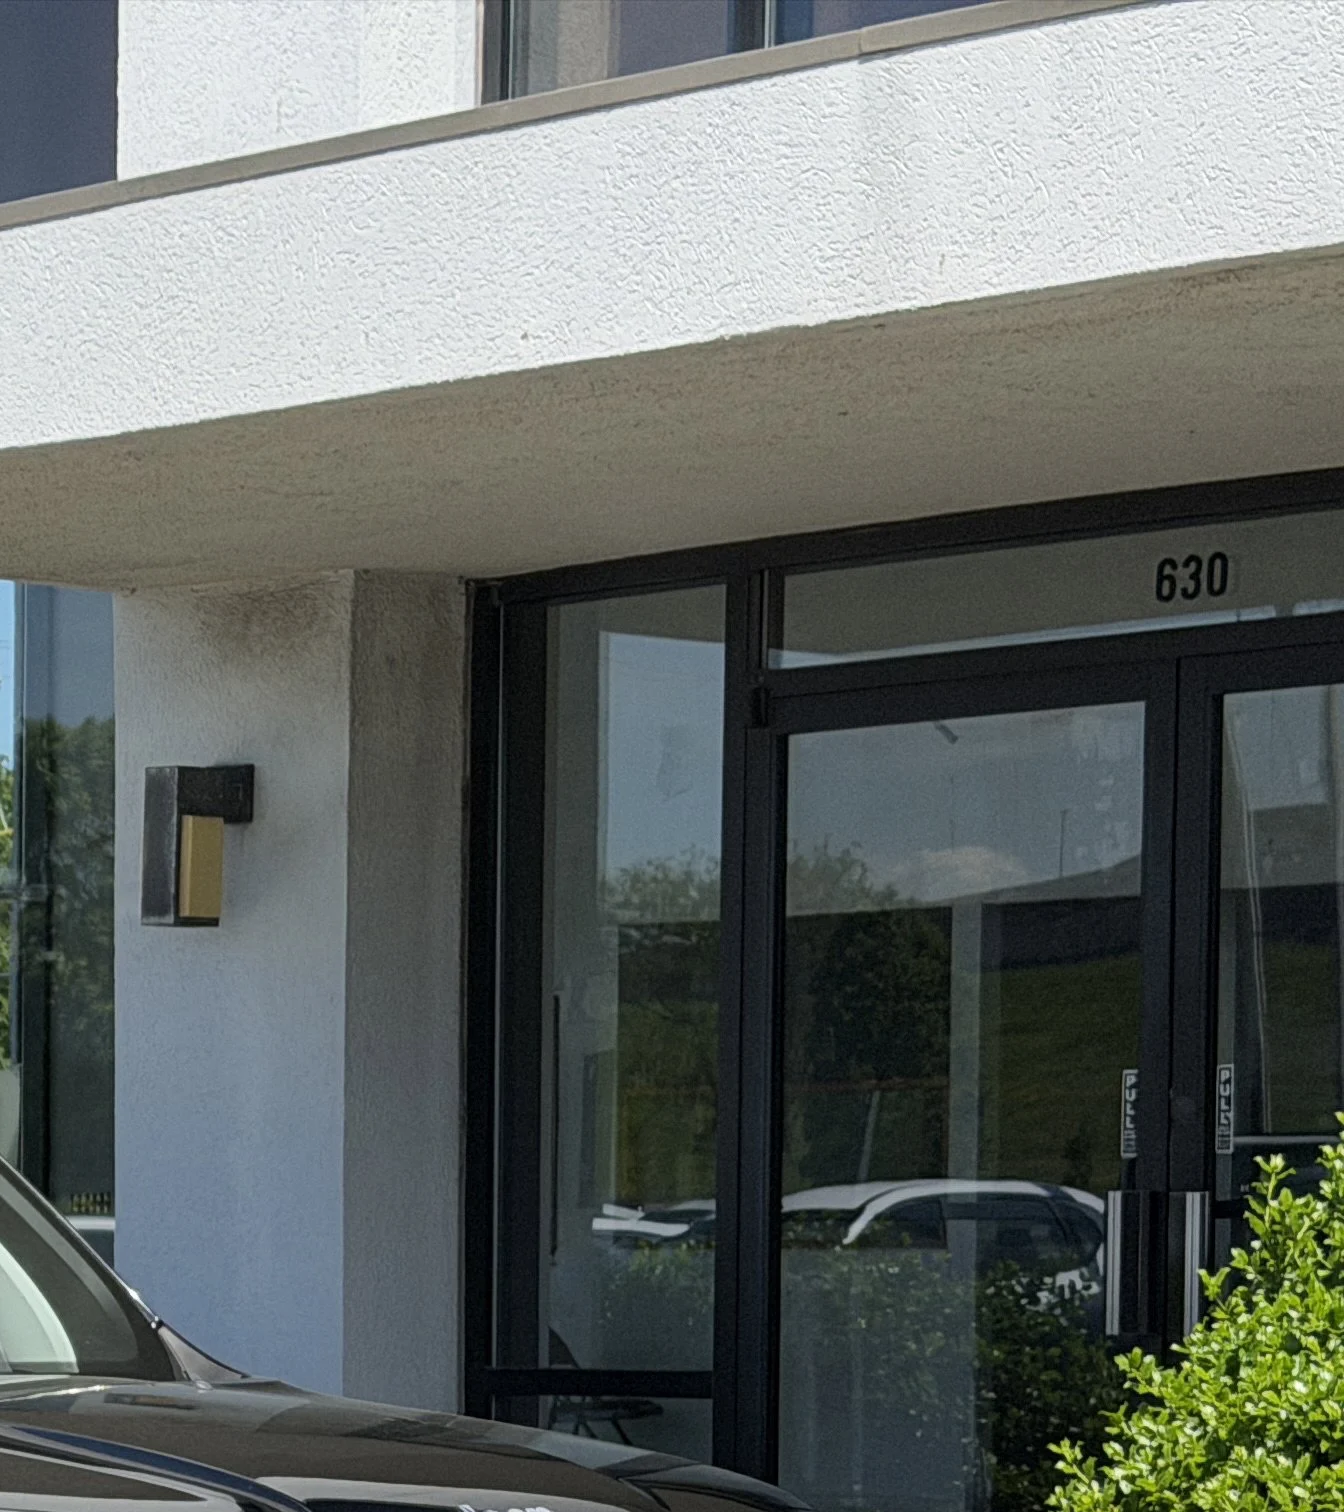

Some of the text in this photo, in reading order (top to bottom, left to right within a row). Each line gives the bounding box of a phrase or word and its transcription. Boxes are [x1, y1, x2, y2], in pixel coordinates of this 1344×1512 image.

[1156, 552, 1229, 602] 630
[1125, 1074, 1137, 1129] PULL
[1220, 1069, 1231, 1124] PULL
